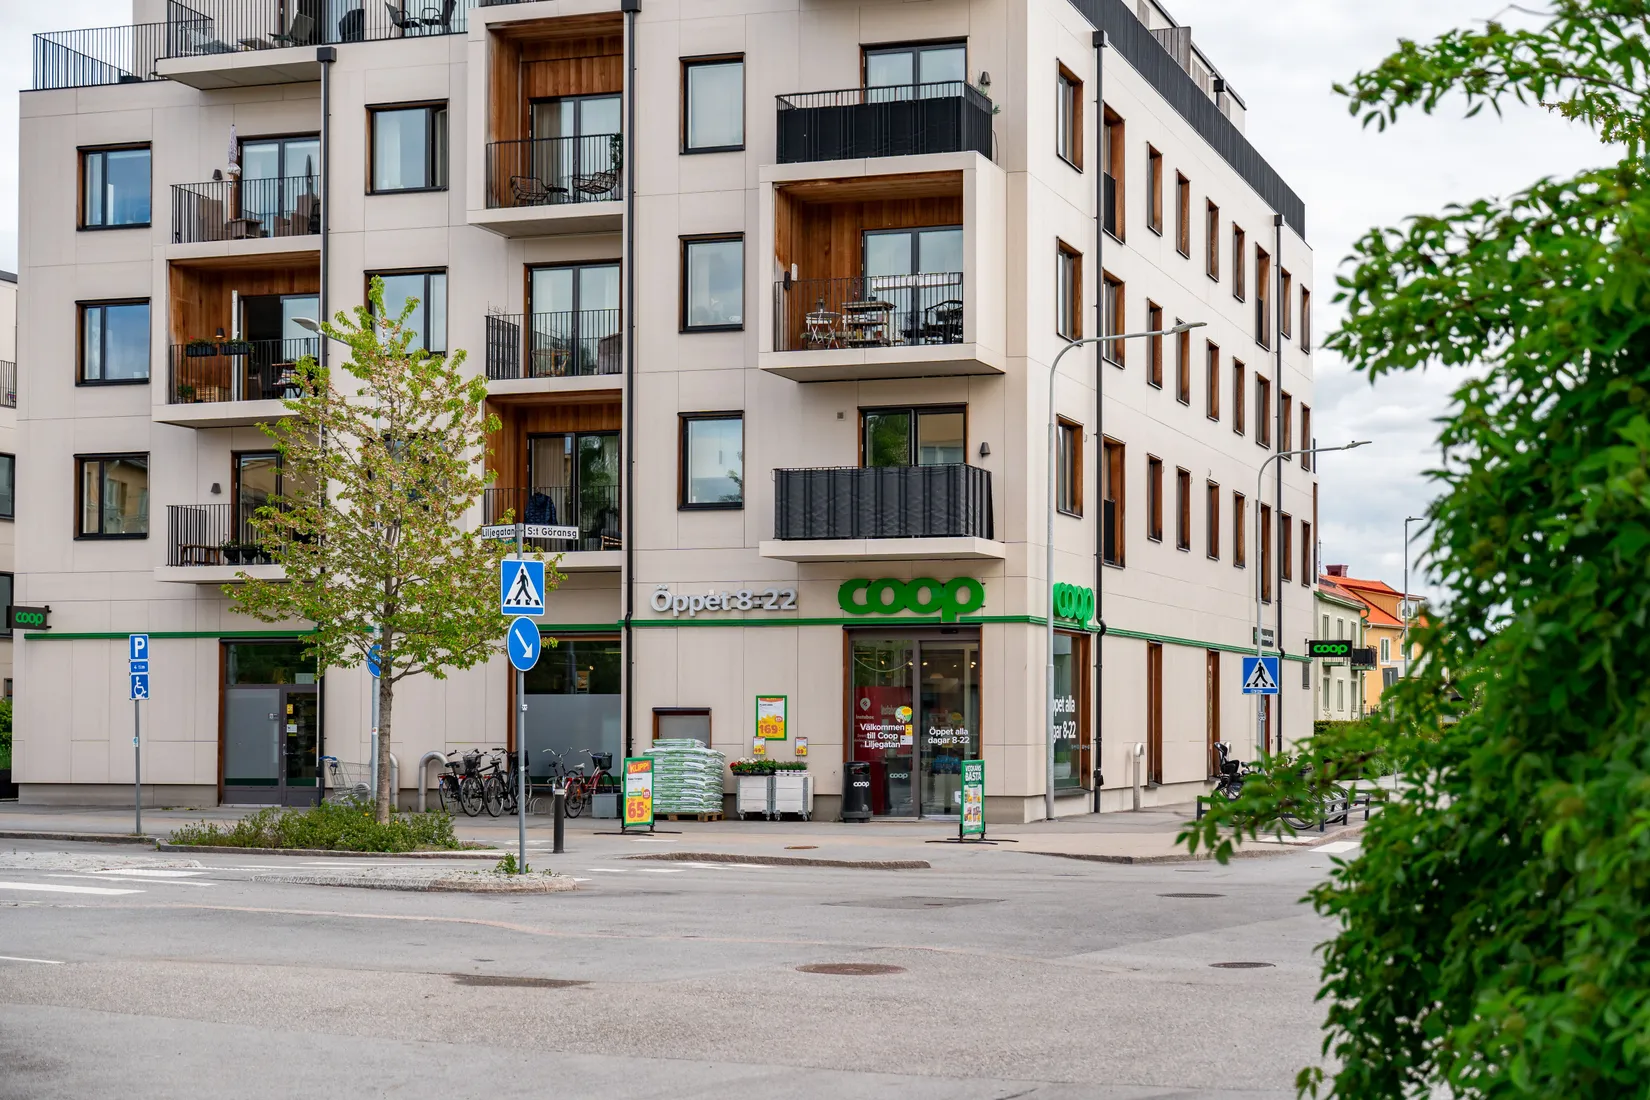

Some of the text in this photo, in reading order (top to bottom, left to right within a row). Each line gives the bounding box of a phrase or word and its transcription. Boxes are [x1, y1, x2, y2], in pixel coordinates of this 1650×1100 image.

[482, 527, 515, 538] Liljegatan
[527, 526, 577, 539] S:t Göransg
[650, 584, 798, 617] Öppet 8-22
[838, 576, 985, 623] coop
[1053, 582, 1095, 630] coop
[15, 611, 44, 626] coop
[134, 637, 146, 658] P
[1313, 644, 1348, 655] coop
[1065, 695, 1076, 713] alla
[860, 723, 905, 731] Välkommen
[929, 726, 954, 737] Öppet
[1063, 720, 1077, 739] 8-22
[866, 732, 876, 740] till
[877, 732, 899, 741] Coop
[928, 736, 970, 746] dagar 8-22
[864, 740, 901, 750] Liljegatan
